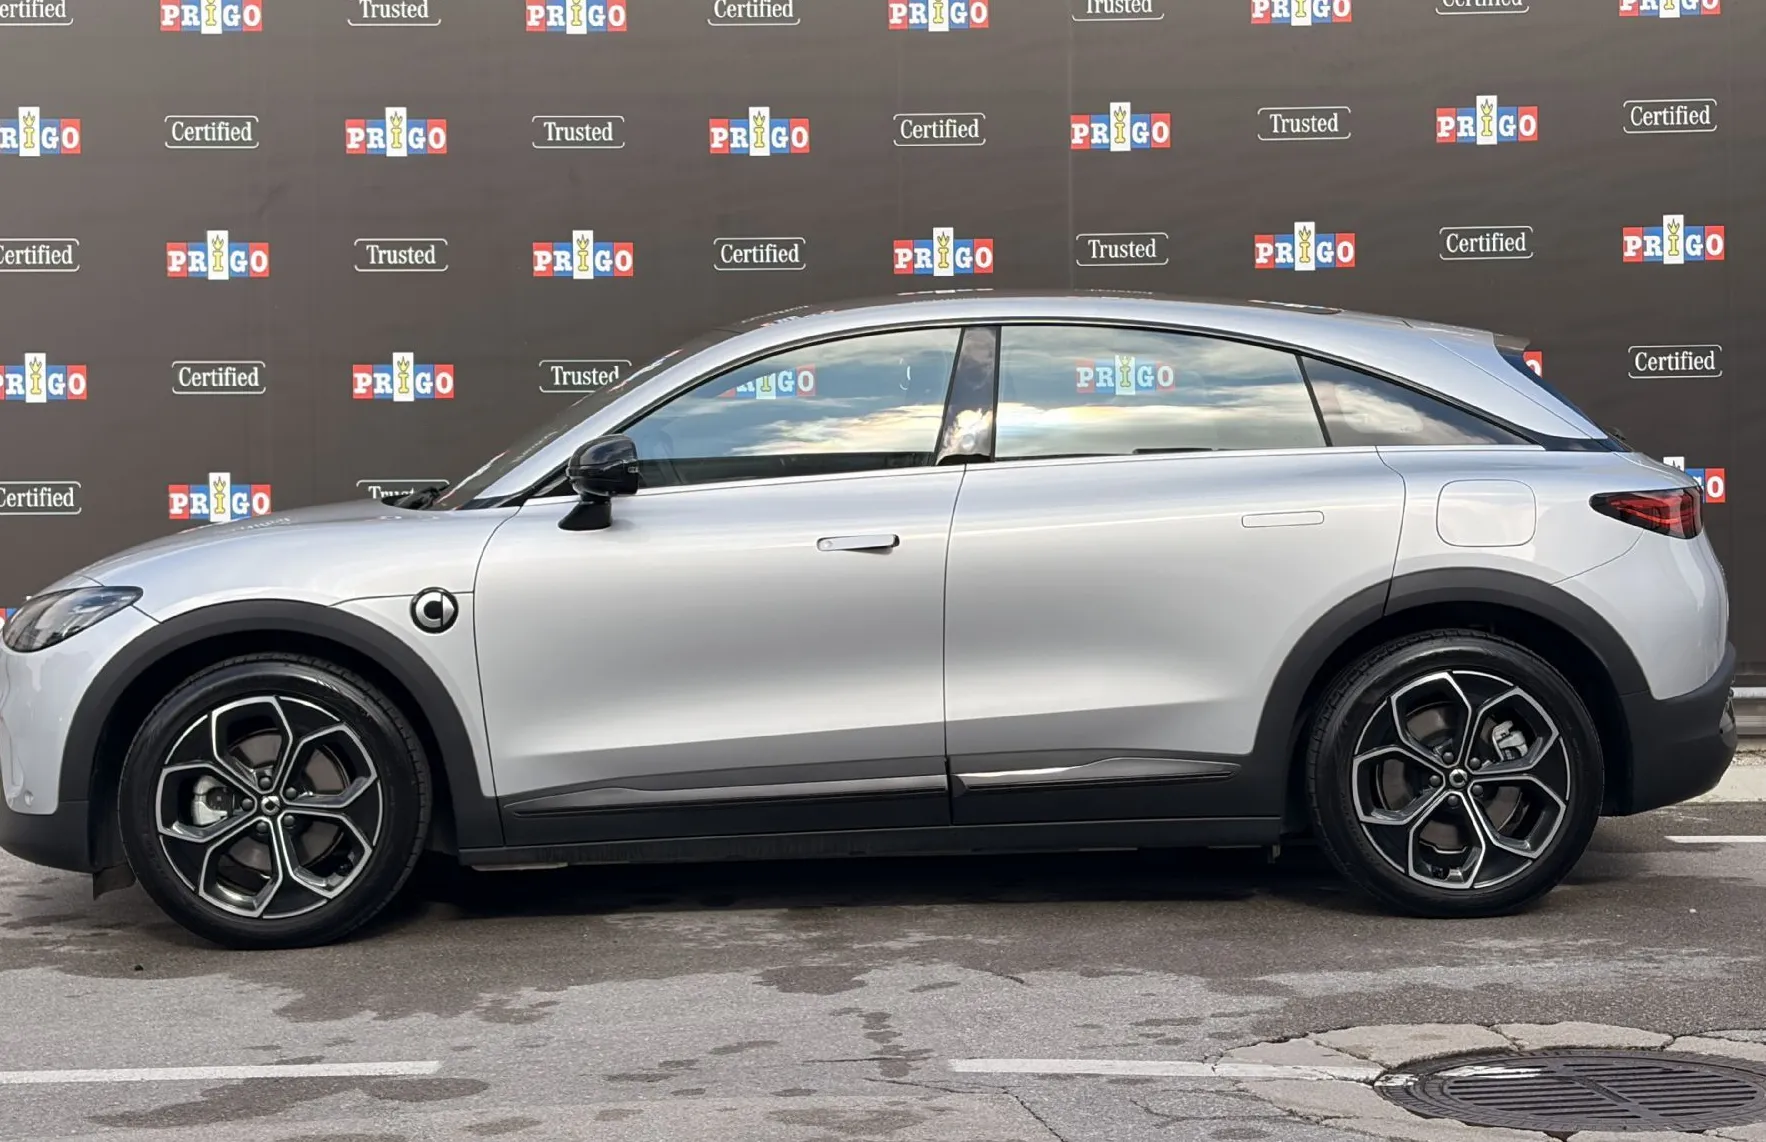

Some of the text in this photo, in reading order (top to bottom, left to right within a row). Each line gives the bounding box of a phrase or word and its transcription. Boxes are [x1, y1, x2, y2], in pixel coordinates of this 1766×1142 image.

[0, 0, 66, 18] ertified
[161, 3, 262, 27] PRIGO
[359, 0, 429, 18] Trusted
[526, 3, 626, 27] PRIGO
[714, 0, 794, 18] Certified
[889, 1, 988, 24] PRIGO
[1269, 113, 1339, 133] Trusted
[1437, 108, 1537, 137] PRIGO
[1630, 105, 1711, 126] Certified
[0, 120, 79, 149] RIGO
[172, 121, 252, 142] Certified
[346, 120, 446, 149] PRIGO
[543, 121, 614, 142] Trusted
[710, 119, 809, 149] PRIGO
[901, 119, 980, 140] Certified
[1071, 115, 1170, 145] PRIGO
[720, 243, 800, 264] Certified
[1088, 238, 1157, 259] Trusted
[1255, 234, 1355, 264] PRIGO
[1446, 232, 1526, 253] Certified
[1624, 227, 1724, 257] PRIGO
[167, 244, 269, 273] PRIGO
[366, 244, 436, 265] Trusted
[533, 244, 634, 272] PRIGO
[894, 239, 993, 269] PRIGO
[1635, 350, 1715, 371] Certified
[0, 366, 87, 395] RIGO
[179, 367, 259, 388] Certified
[353, 365, 453, 395] PRIGO
[737, 370, 814, 392] IGO
[1076, 360, 1174, 388] PRIGO
[169, 485, 271, 515] PRIGO
